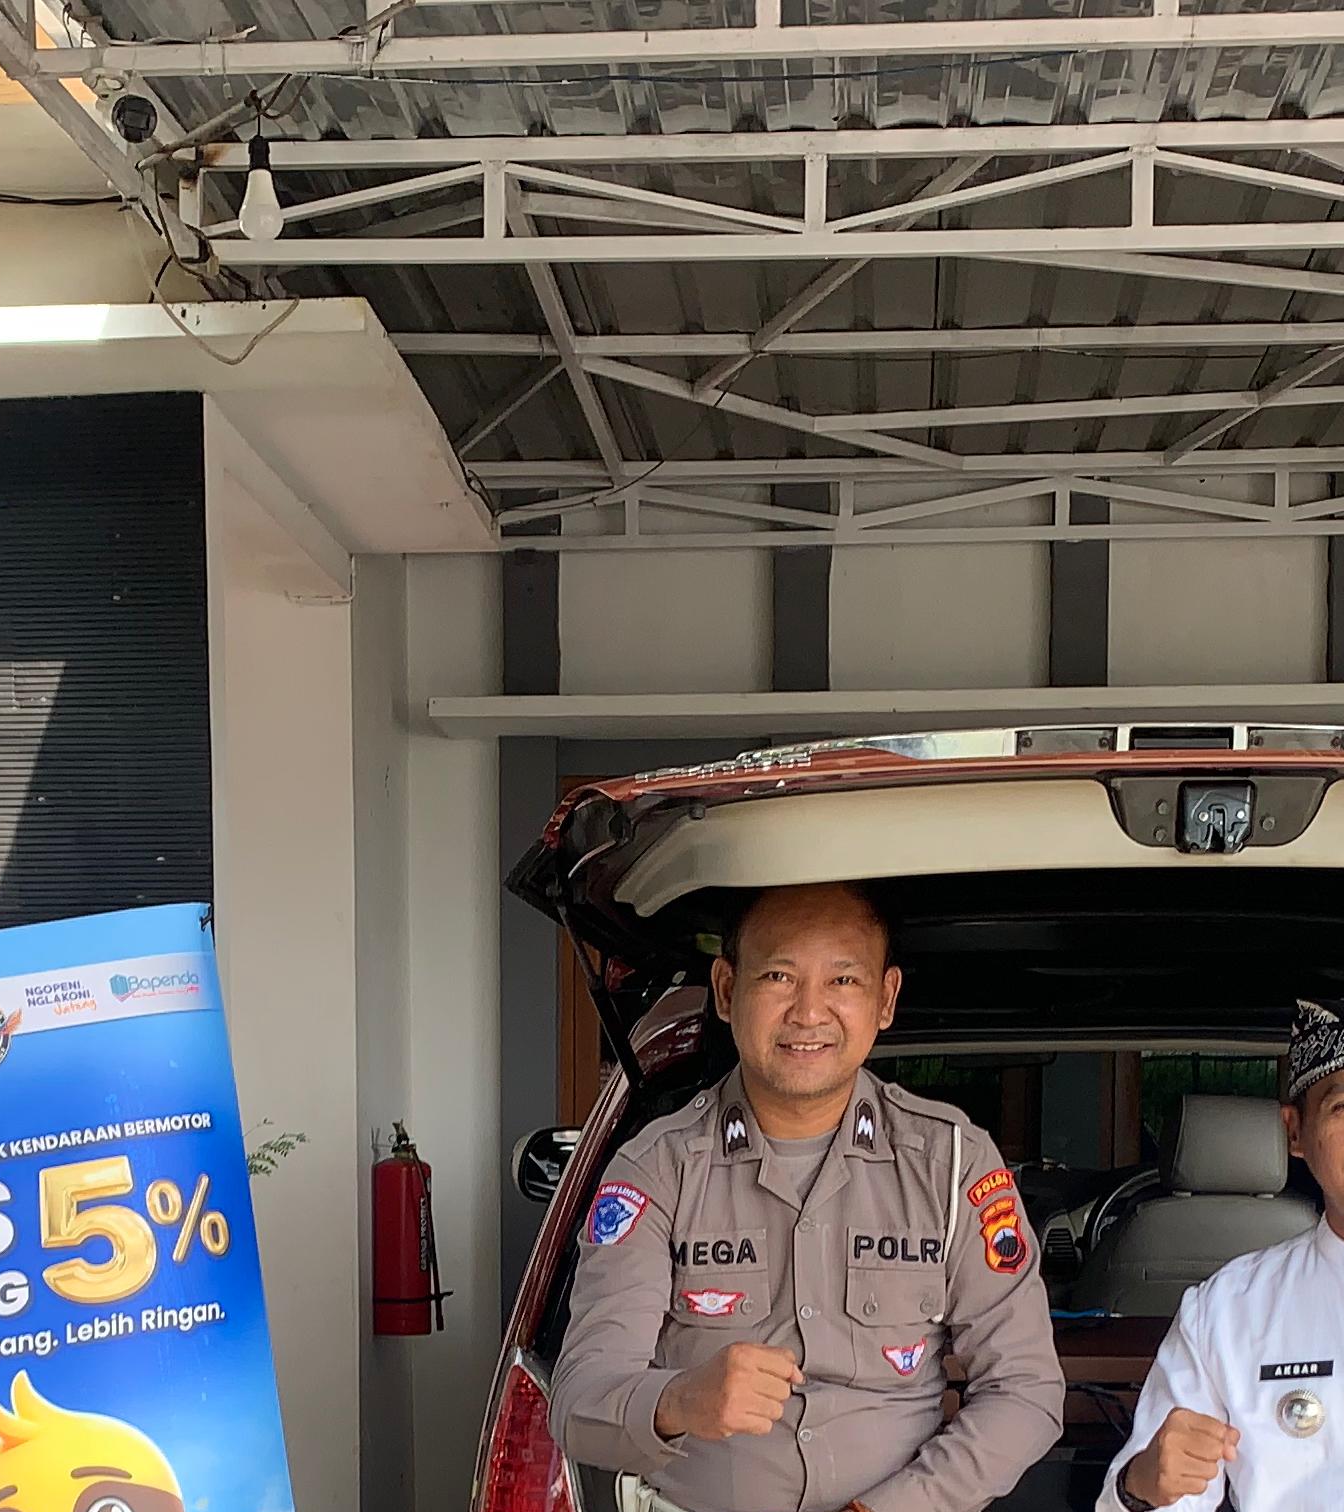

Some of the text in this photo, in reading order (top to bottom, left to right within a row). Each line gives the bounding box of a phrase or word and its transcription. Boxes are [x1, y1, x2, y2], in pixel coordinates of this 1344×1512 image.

[9, 1124, 121, 1156] KENDARAAN
[124, 1112, 211, 1138] BERMOTOR
[669, 1238, 757, 1267] MEGA
[66, 1312, 134, 1344] Lebih
[141, 1300, 226, 1333] Ringan.
